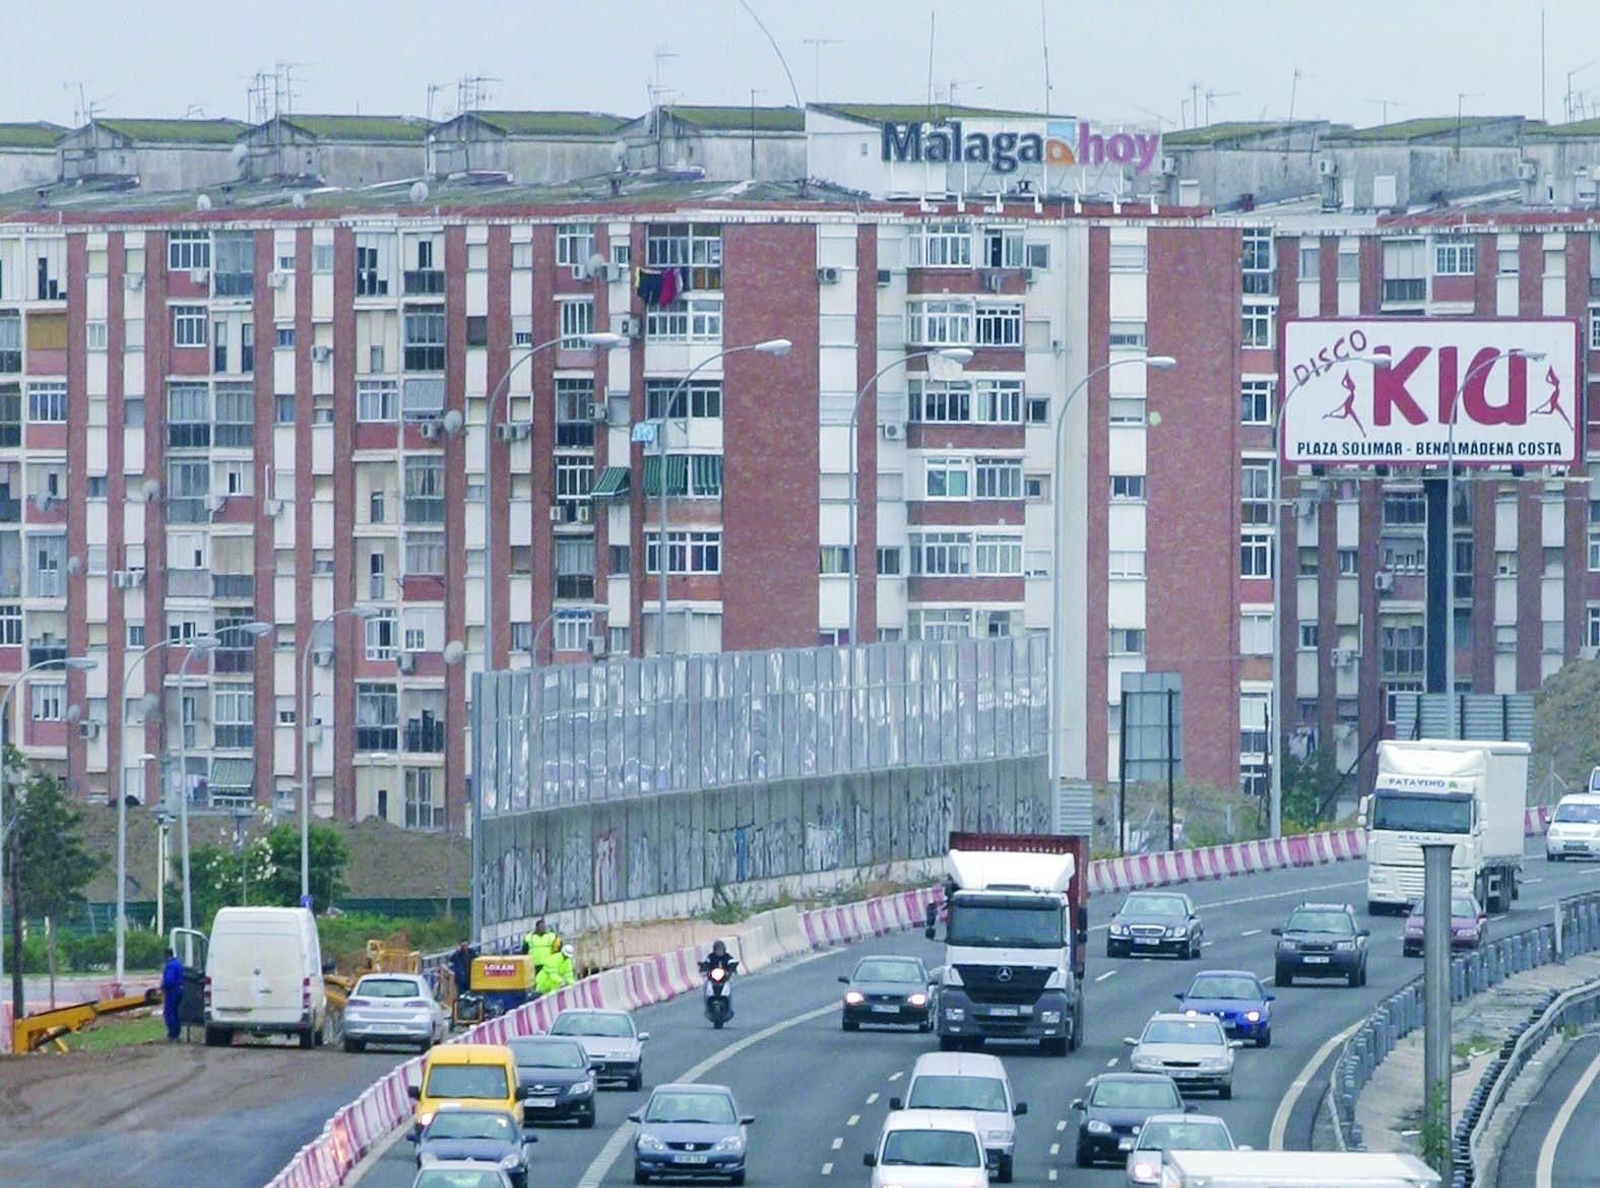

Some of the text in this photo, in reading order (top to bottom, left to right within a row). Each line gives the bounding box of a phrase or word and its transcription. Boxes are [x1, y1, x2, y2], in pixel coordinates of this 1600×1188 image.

[1078, 121, 1160, 175] hoy
[1292, 330, 1368, 387] DISCO
[1297, 441, 1338, 456] PLAZA
[1341, 441, 1403, 456] SOLIMAR
[1518, 442, 1562, 456] COSTA
